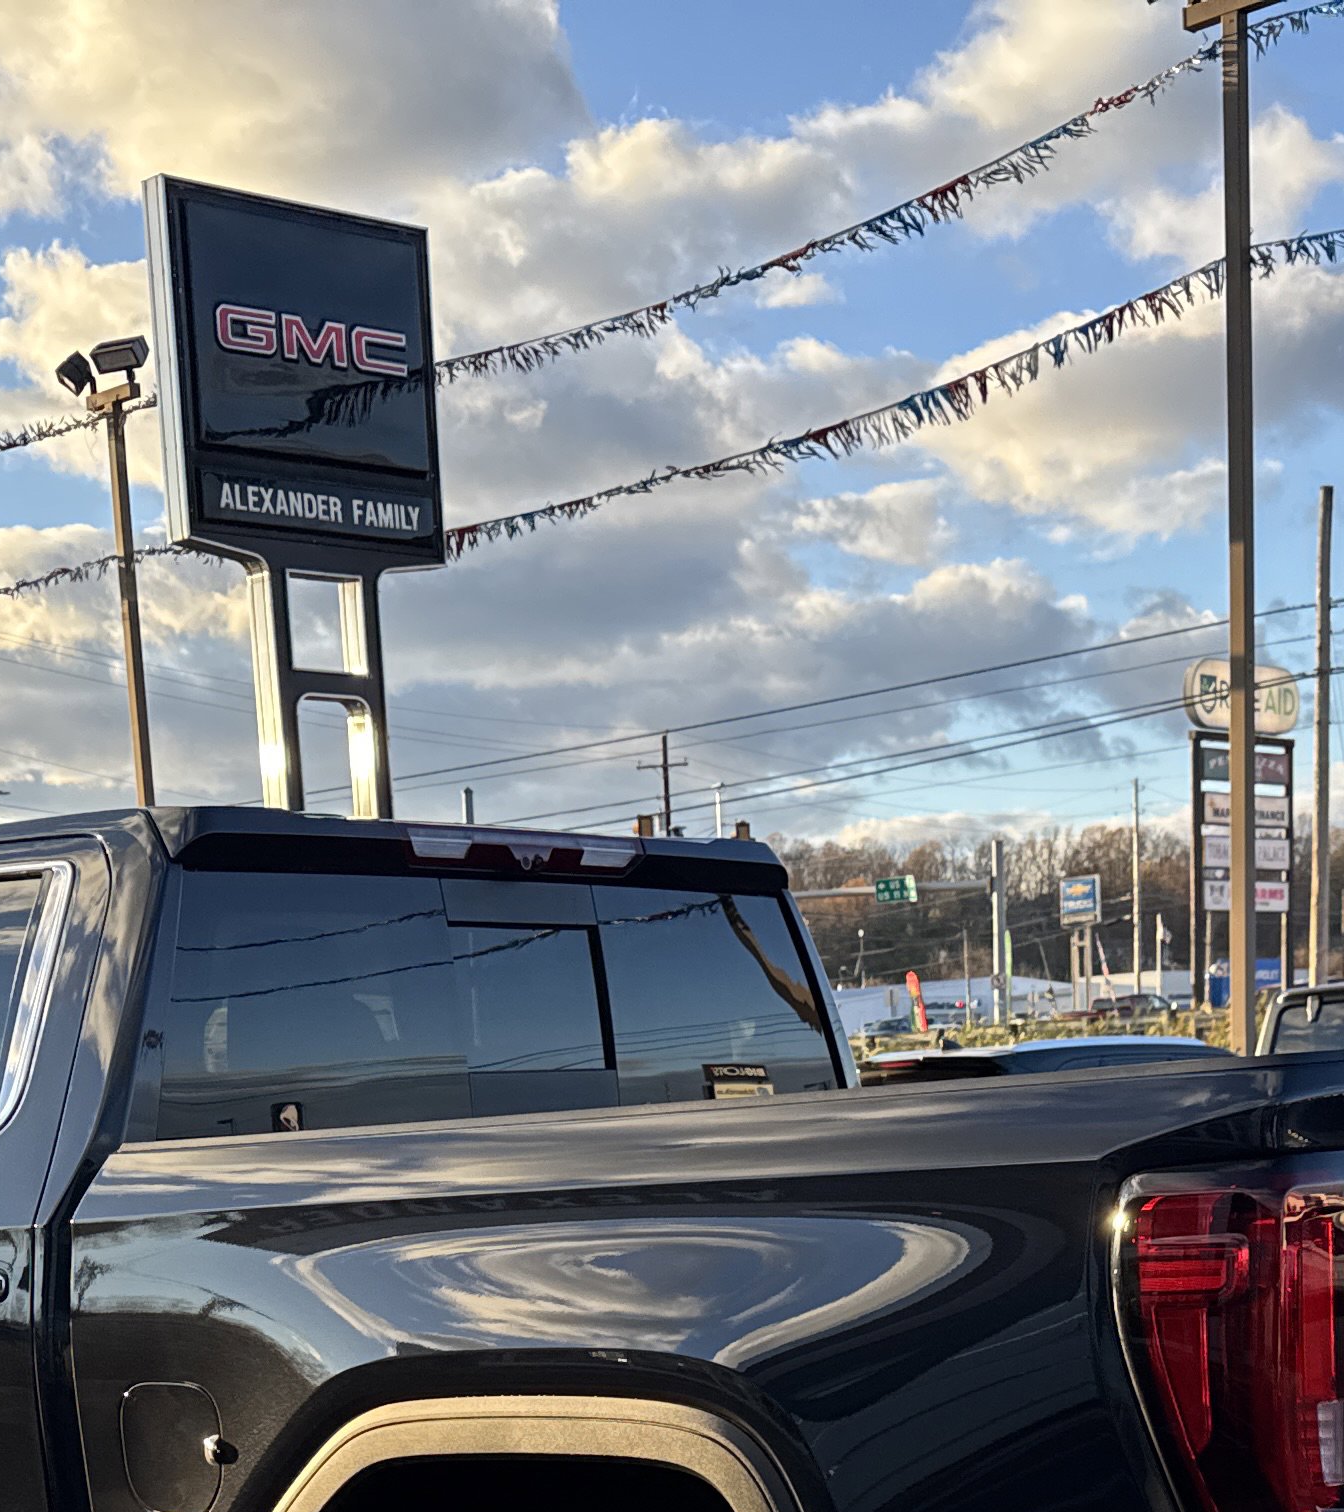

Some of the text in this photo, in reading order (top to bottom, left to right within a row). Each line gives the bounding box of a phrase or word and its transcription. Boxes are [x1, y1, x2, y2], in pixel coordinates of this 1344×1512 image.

[215, 303, 408, 378] GMC
[219, 482, 420, 531] ALEXANDER FAMILY
[1264, 687, 1296, 717] AID
